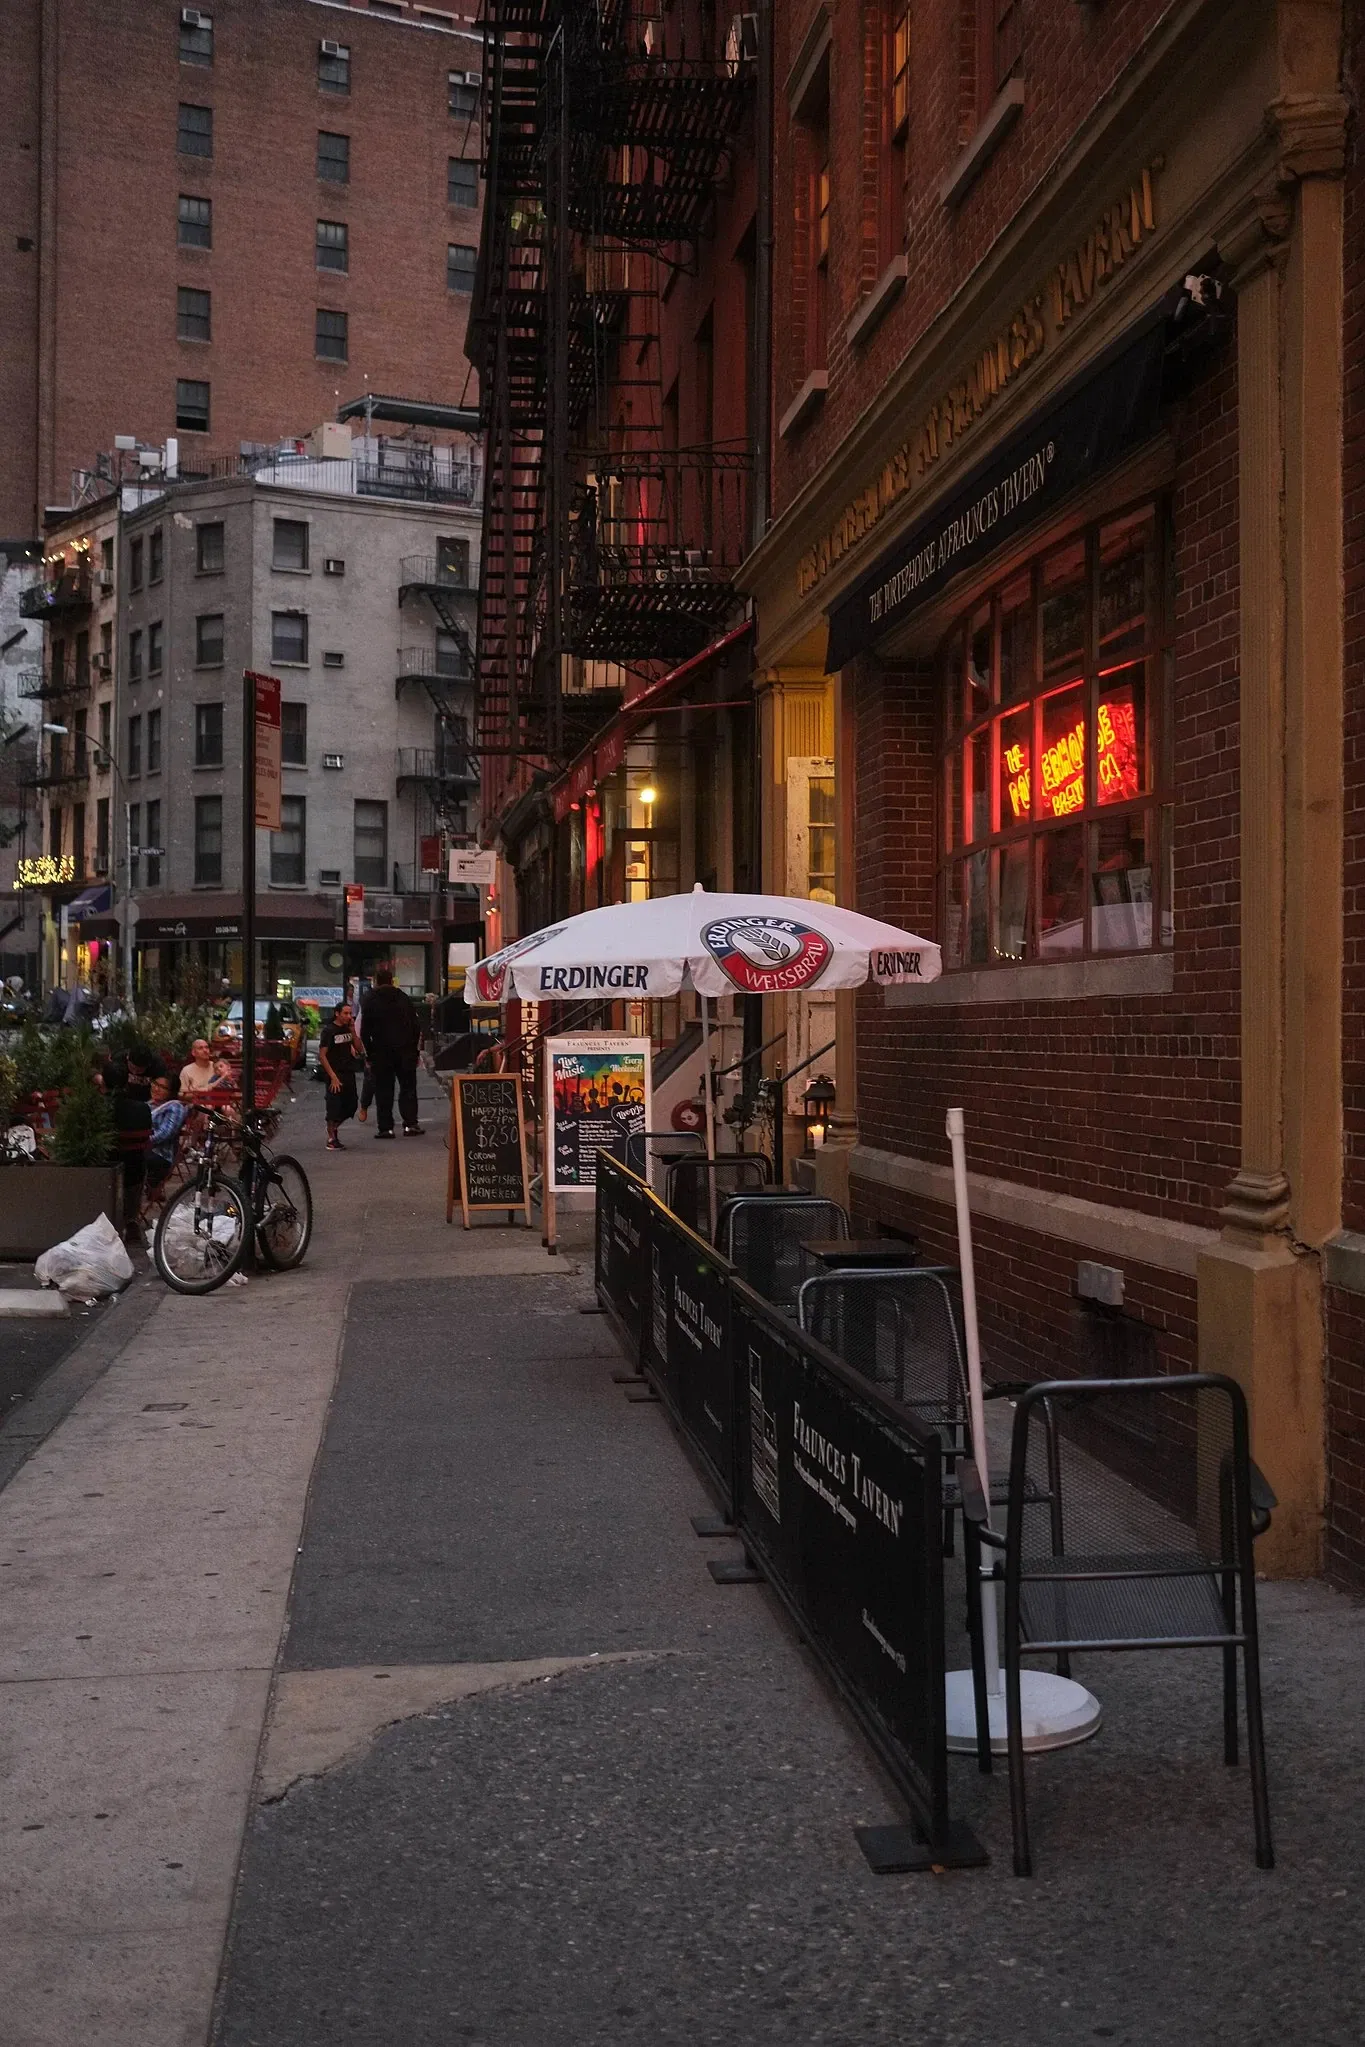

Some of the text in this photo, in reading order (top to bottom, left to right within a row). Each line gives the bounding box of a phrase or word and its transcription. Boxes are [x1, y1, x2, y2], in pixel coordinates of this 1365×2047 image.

[869, 587, 882, 623] THE
[884, 541, 936, 614] PORTERHOUSE
[946, 487, 999, 559] FRAUNCES
[1004, 744, 1025, 773] THE
[709, 917, 797, 950] ERDINGER
[540, 965, 649, 993] ERDINGER
[744, 941, 825, 991] WEISSBRÄU
[555, 1066, 586, 1082] Music
[557, 1056, 579, 1069] Live
[471, 1107, 497, 1119] HAPPY
[793, 1400, 847, 1486] FRAUNCES
